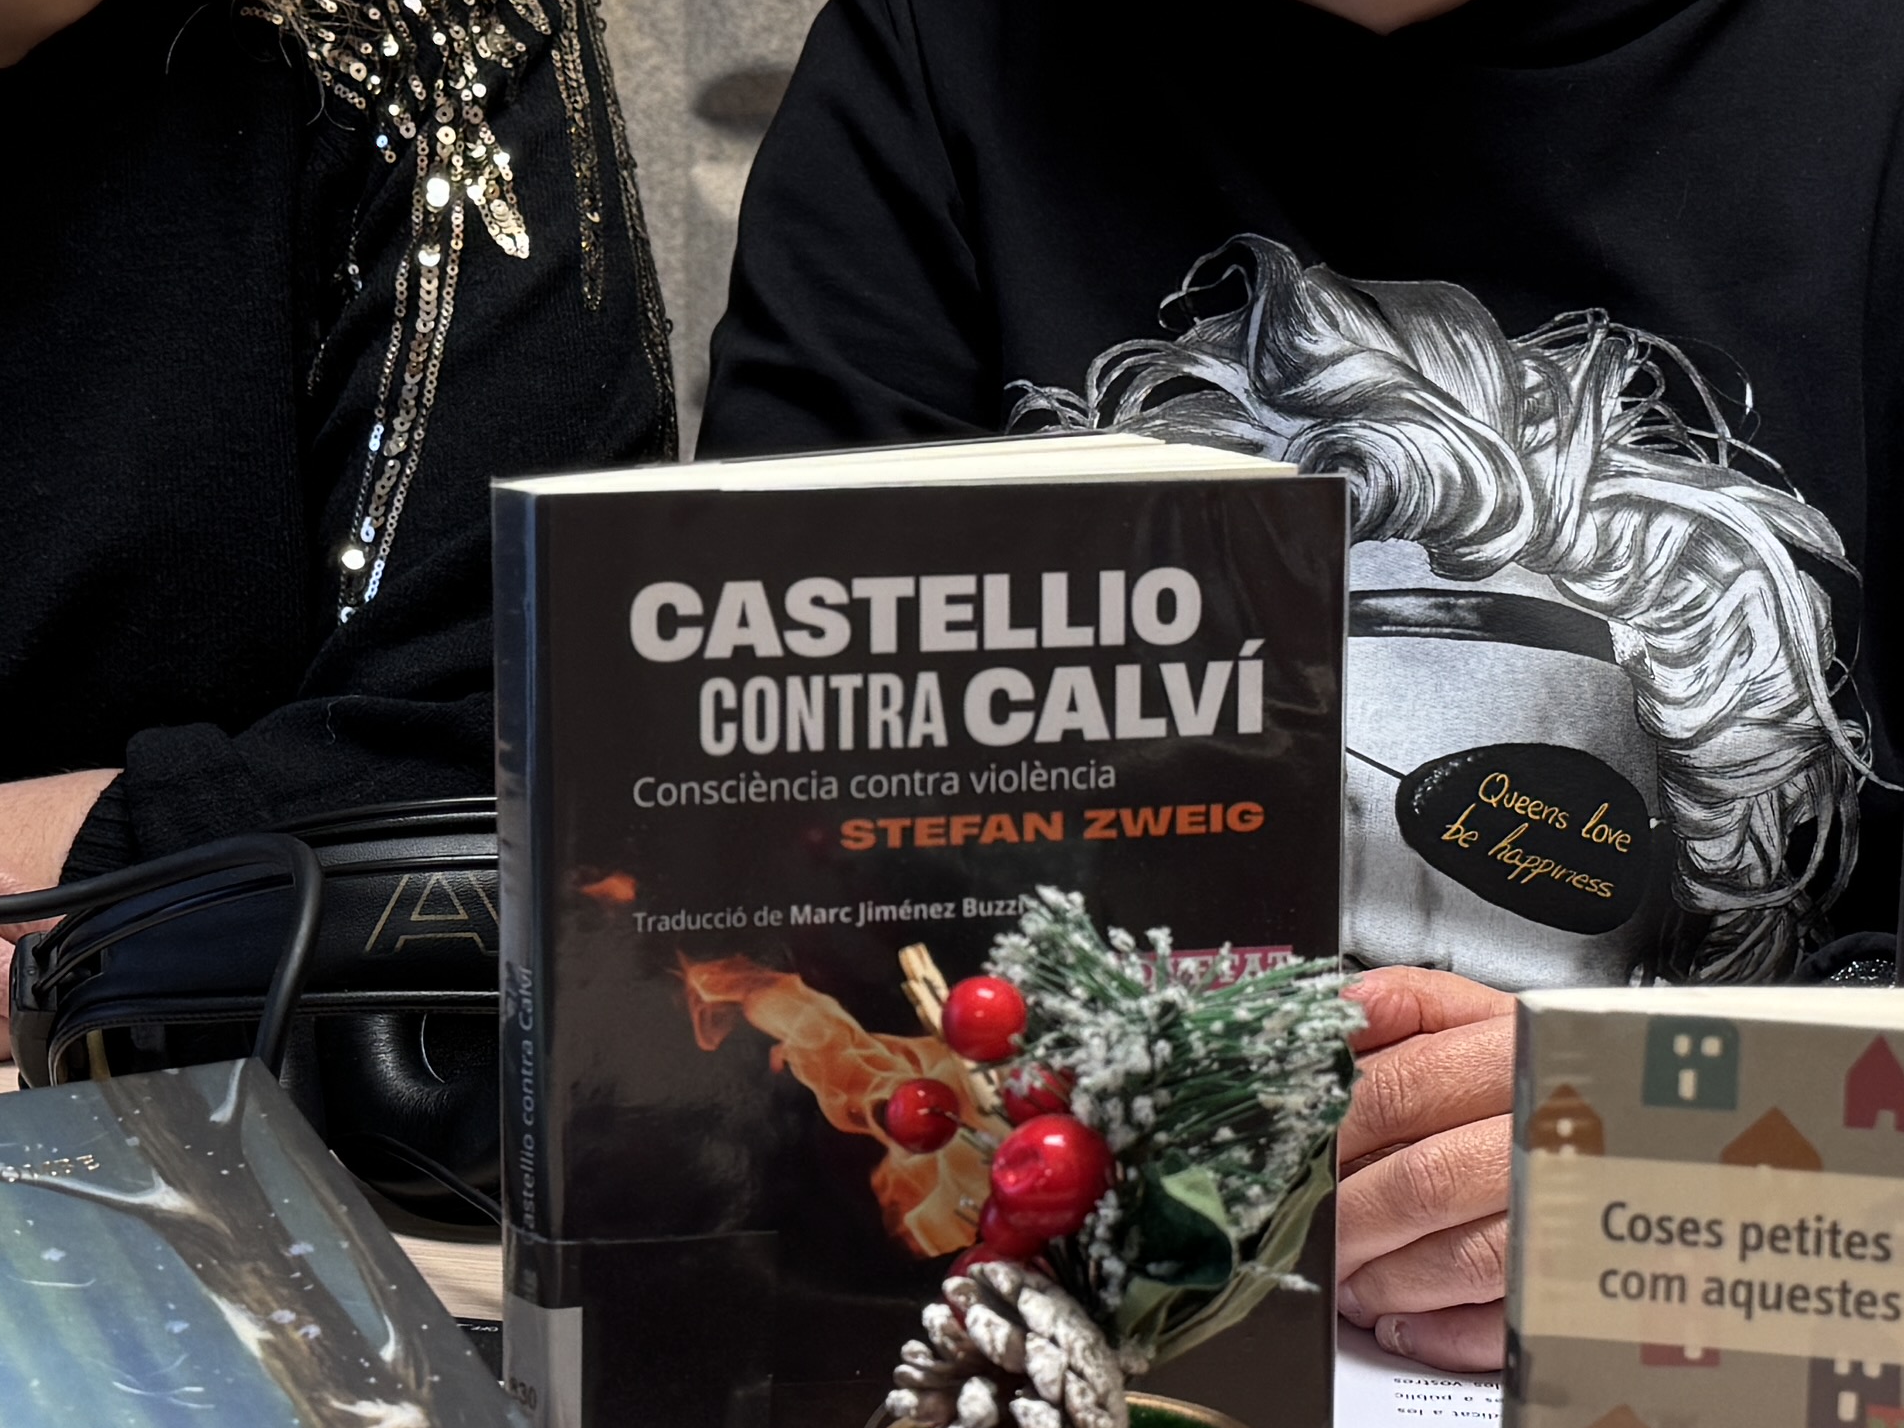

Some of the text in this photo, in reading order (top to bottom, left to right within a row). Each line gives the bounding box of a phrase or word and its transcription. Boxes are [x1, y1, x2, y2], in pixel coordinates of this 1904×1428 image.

[629, 566, 1203, 663] CASTELLIO
[699, 637, 1266, 756] CONTRA CALVÍ
[631, 758, 1118, 810] Consciència contra violència
[1477, 771, 1633, 854] Queens love
[838, 801, 1266, 852] STEFAN ZWEIG
[1439, 802, 1616, 900] be happiness
[632, 904, 750, 934] Traducció
[753, 902, 785, 930] de
[789, 899, 854, 927] Marc
[855, 893, 957, 929] Jiménez
[1600, 1199, 1893, 1265] Coses petites
[1598, 1266, 1904, 1324] com aquestes
